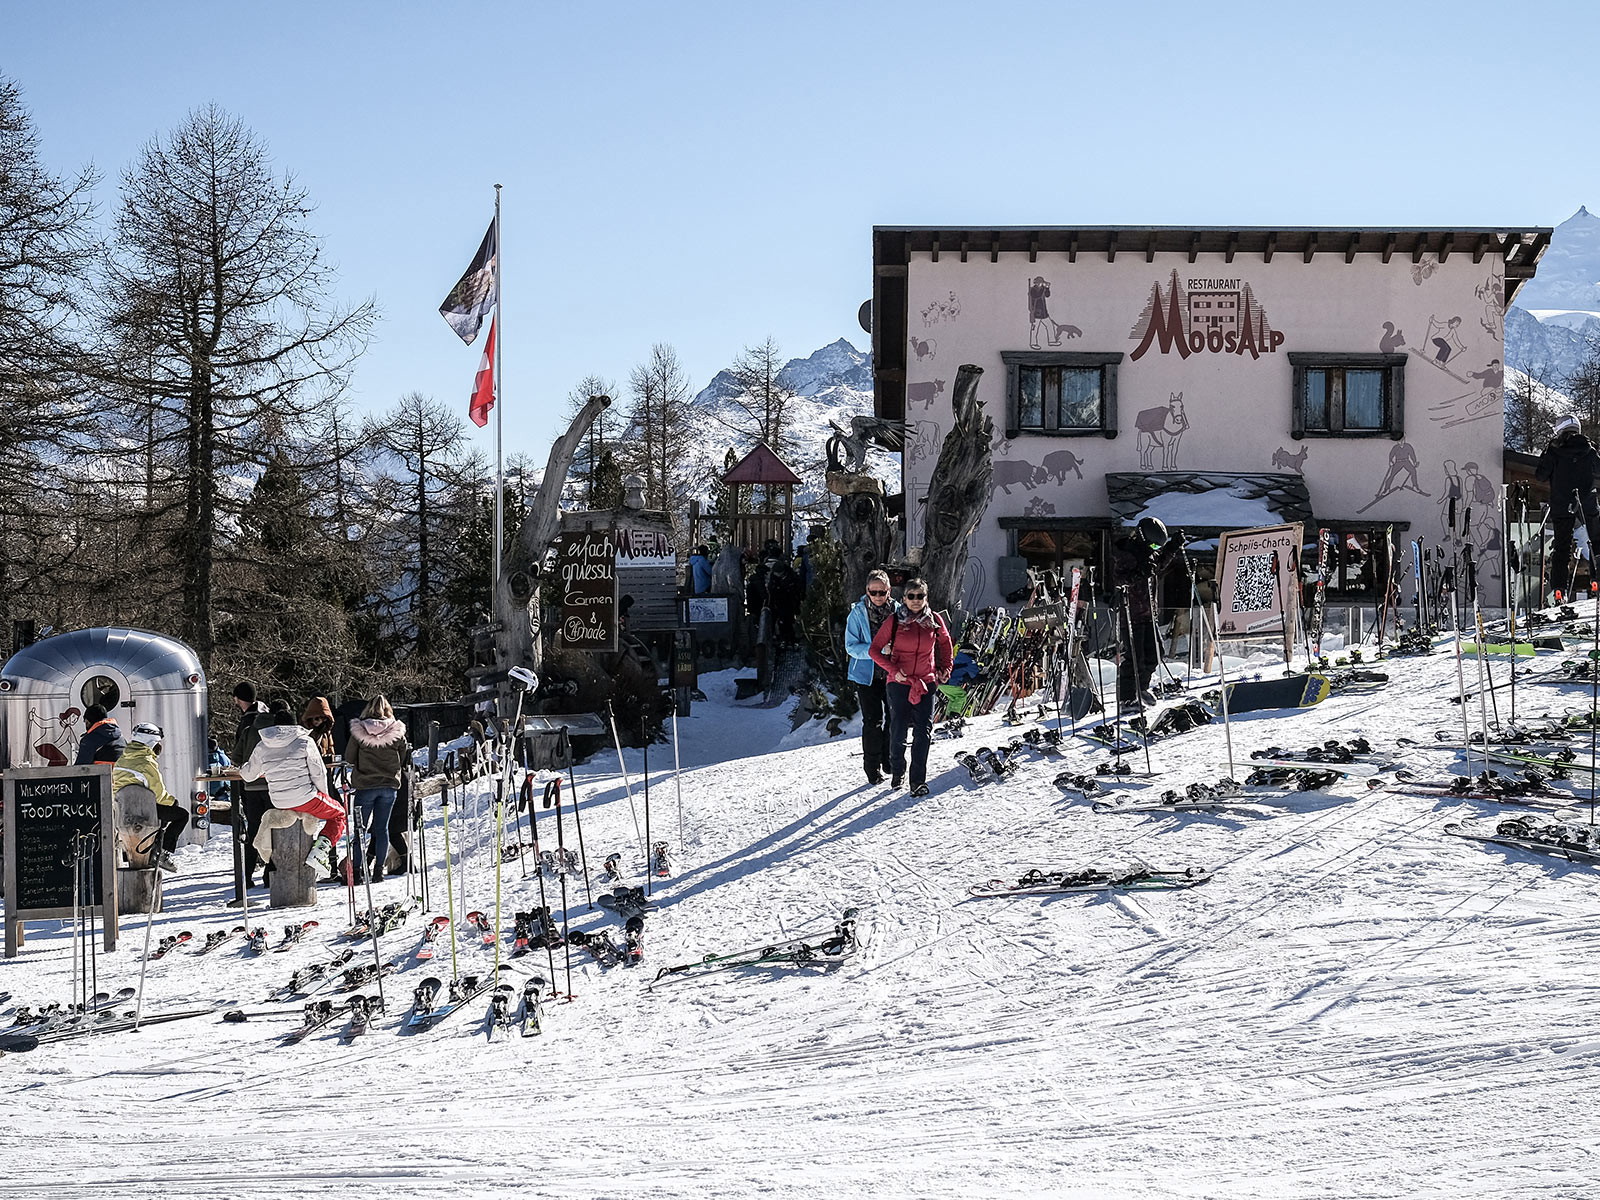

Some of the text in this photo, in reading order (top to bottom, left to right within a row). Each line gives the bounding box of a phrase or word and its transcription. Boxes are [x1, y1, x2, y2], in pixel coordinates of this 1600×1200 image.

[1188, 278, 1241, 290] RESTAURANT
[567, 534, 614, 566] eifach
[1228, 537, 1291, 555] Schpiis-Charta
[1320, 531, 1330, 577] ATOMIC
[563, 590, 613, 607] Carmen
[20, 782, 73, 798] WILKOMMEN
[20, 802, 98, 819] FOODTRUCK!
